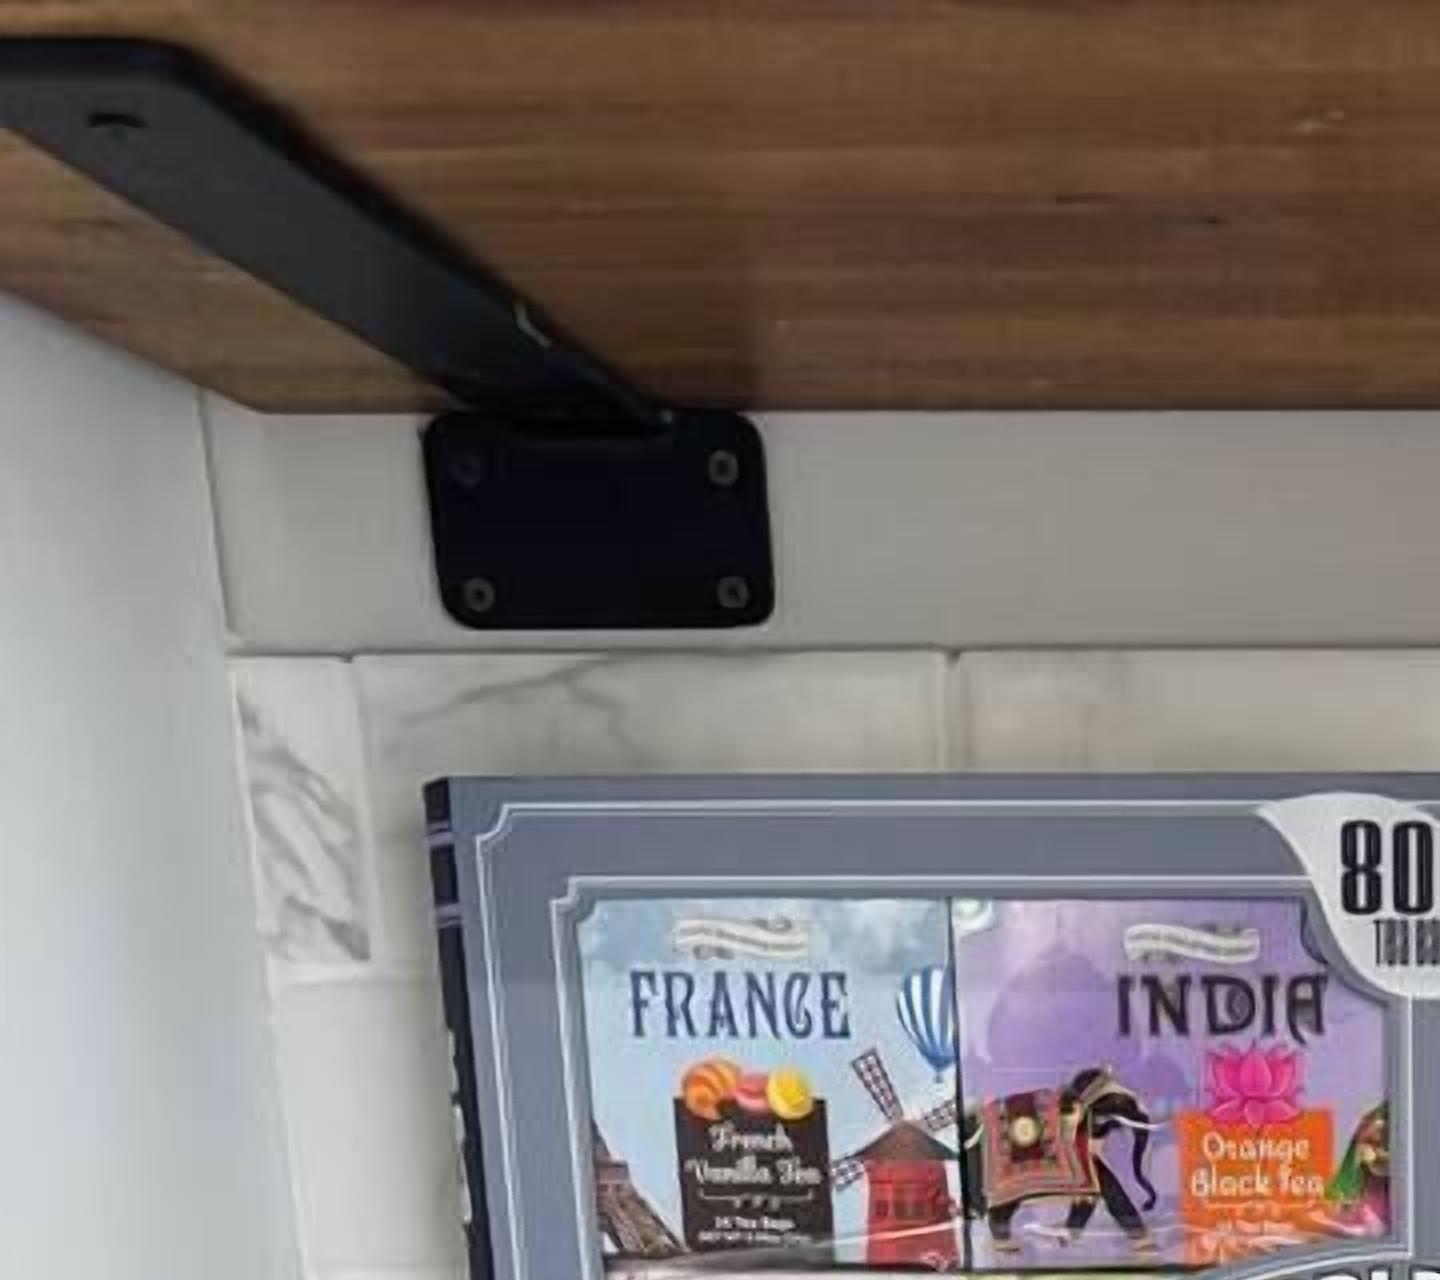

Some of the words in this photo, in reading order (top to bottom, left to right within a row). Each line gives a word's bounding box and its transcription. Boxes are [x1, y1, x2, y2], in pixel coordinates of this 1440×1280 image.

[1341, 820, 1433, 915] 80
[629, 969, 851, 1039] FRANCE
[1117, 973, 1328, 1044] INDIA
[1192, 1164, 1272, 1197] Black
[1279, 1164, 1325, 1197] Tea
[1203, 1131, 1310, 1163] Orange
